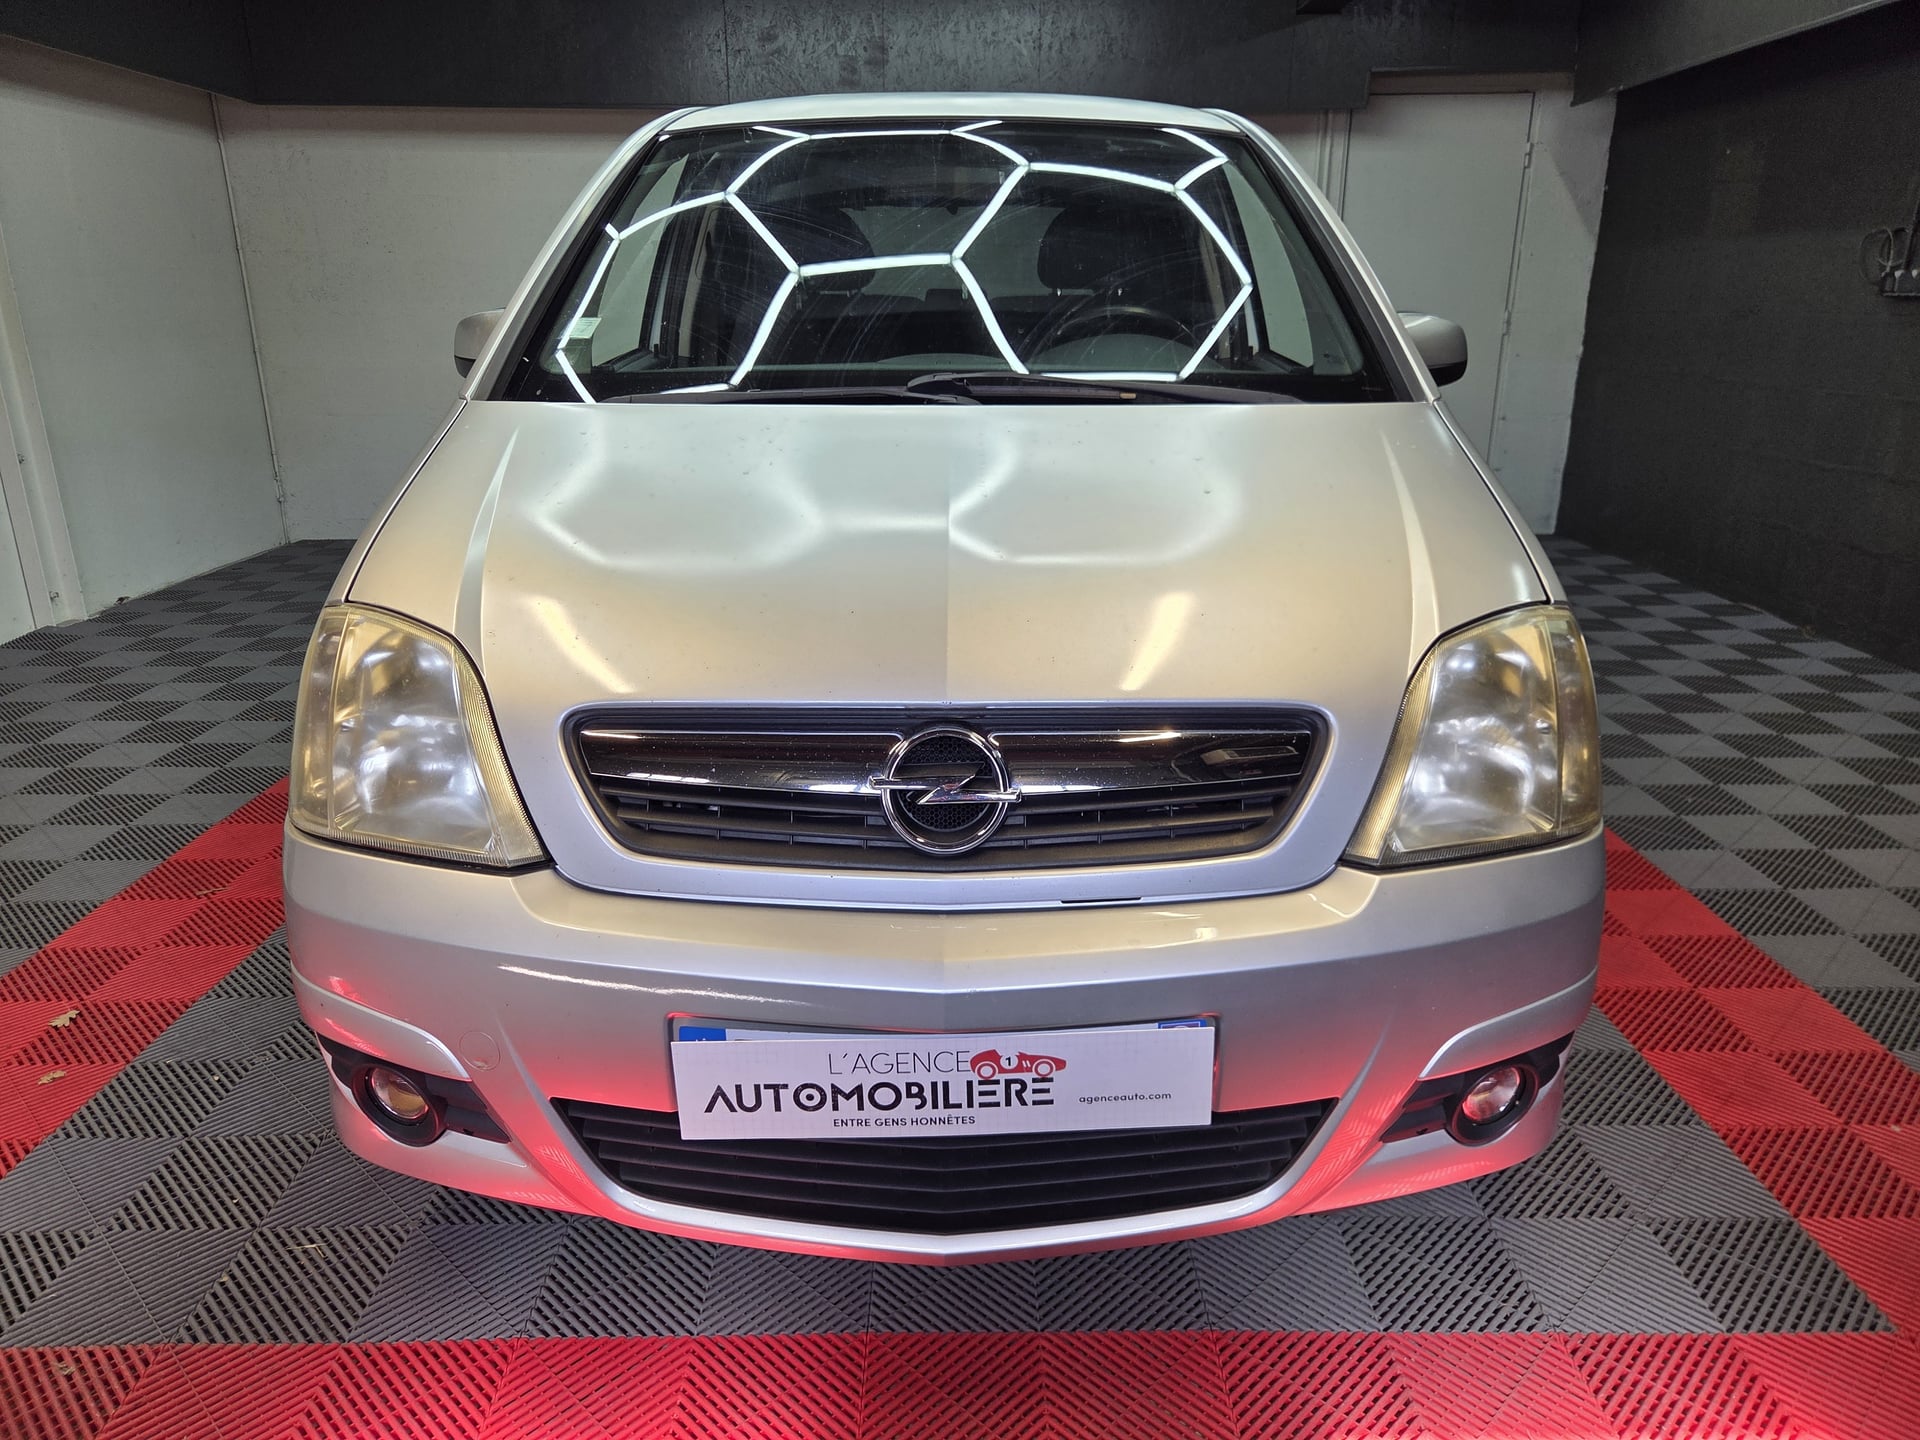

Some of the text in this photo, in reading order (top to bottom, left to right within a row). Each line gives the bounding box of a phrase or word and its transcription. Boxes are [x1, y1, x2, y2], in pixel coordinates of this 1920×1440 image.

[828, 1050, 971, 1075] L'AGENCE
[1005, 1056, 1012, 1067] 1
[1078, 1092, 1172, 1105] agenceauto.com
[833, 1113, 976, 1128] ENTRE GENS HONNÊTES
